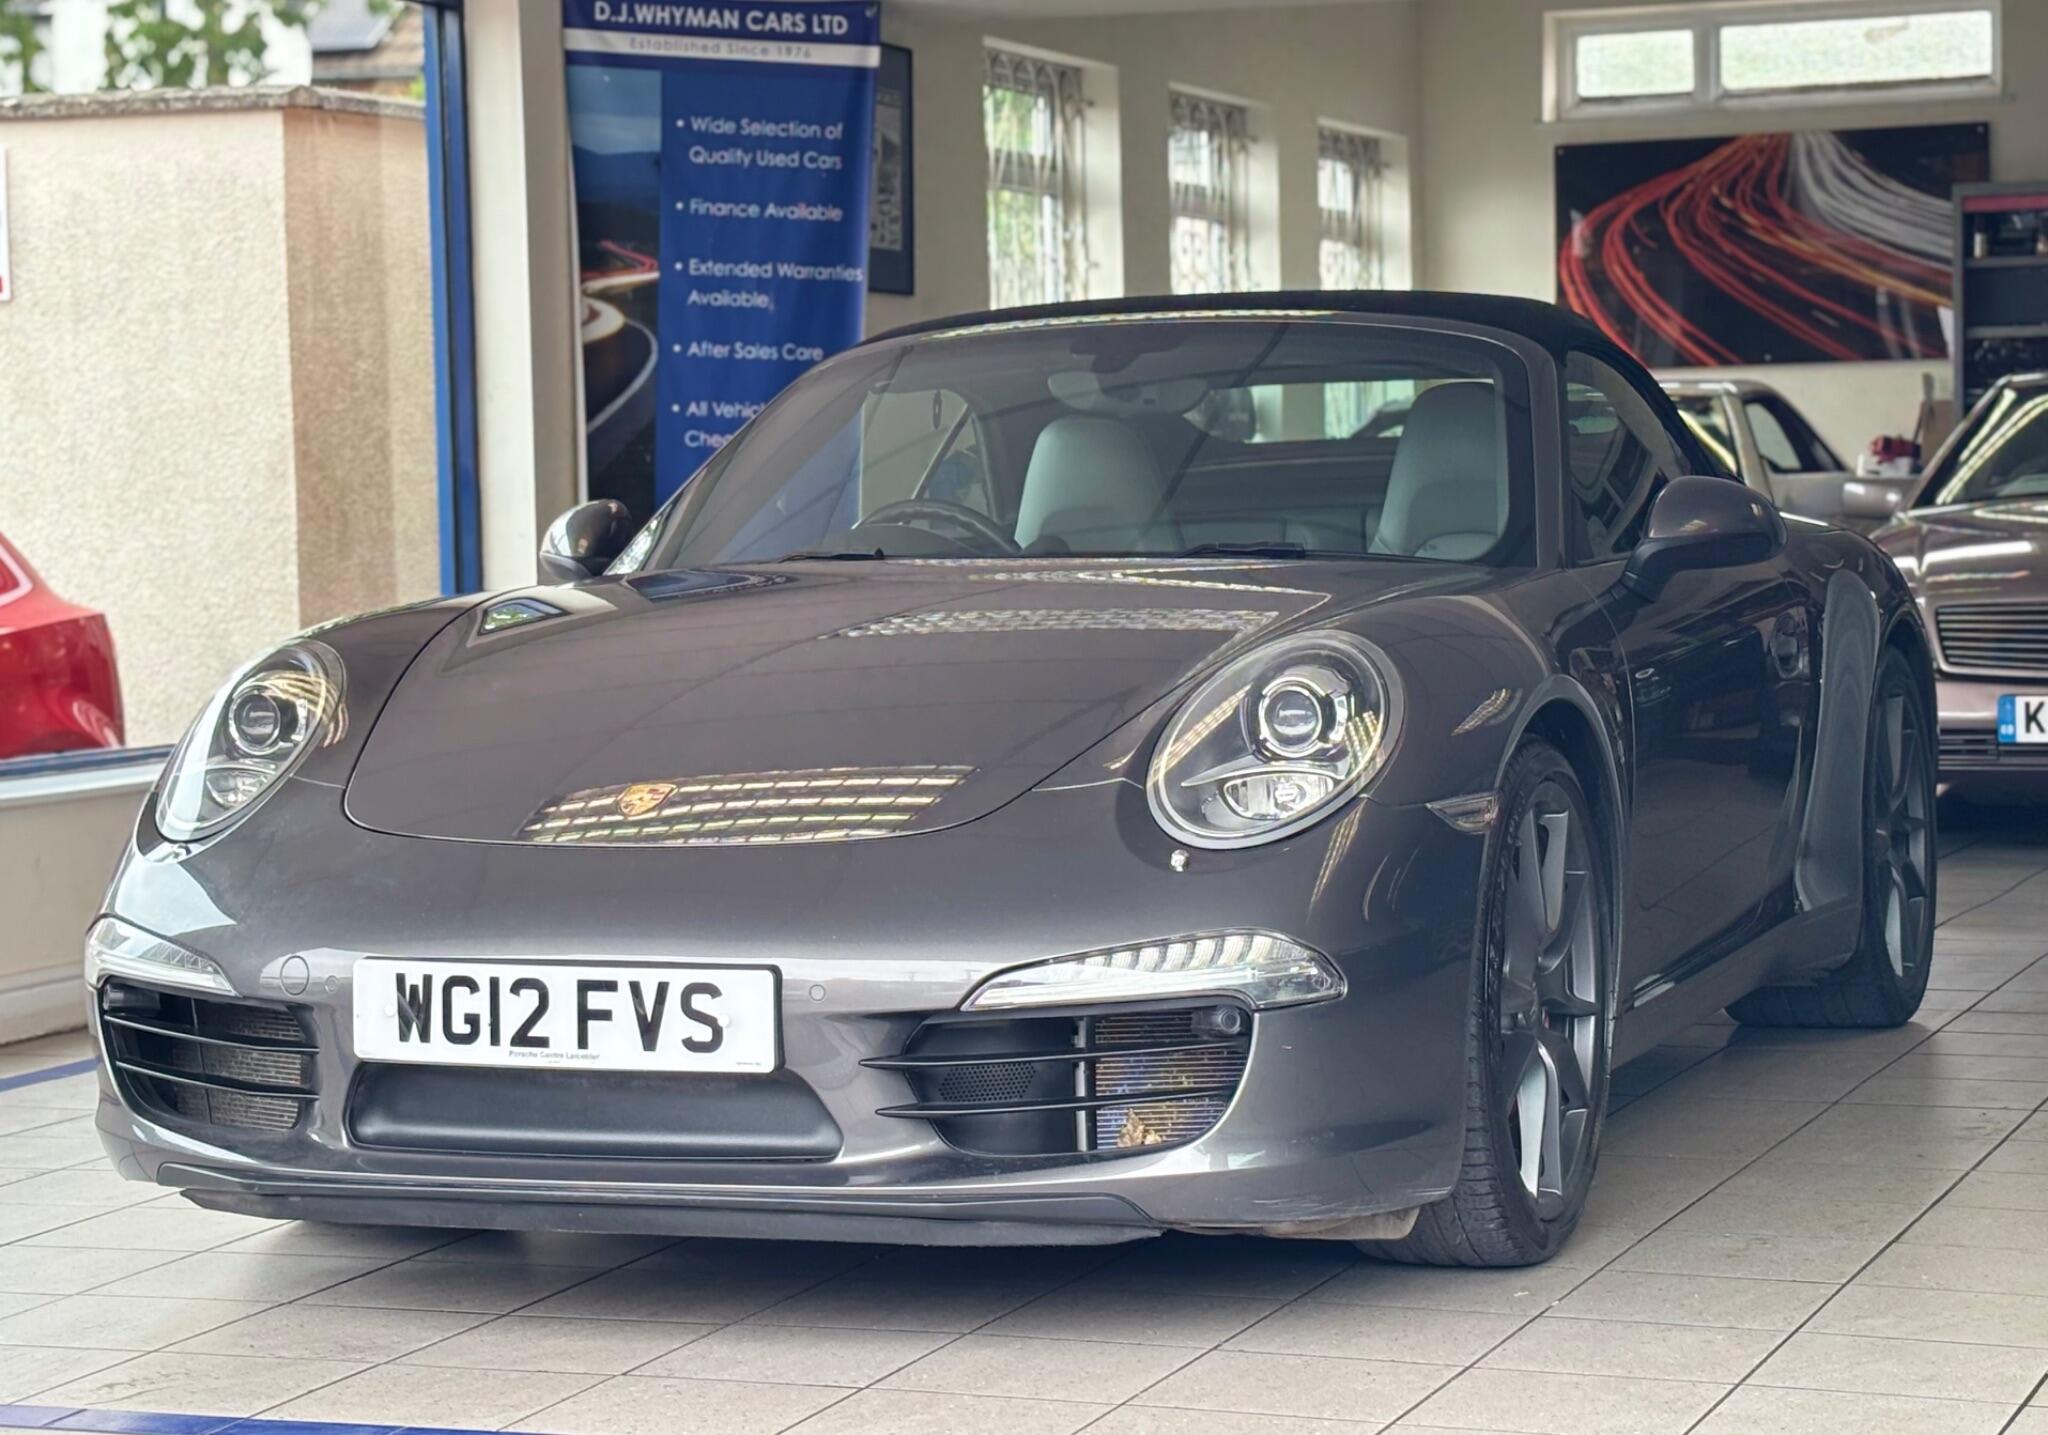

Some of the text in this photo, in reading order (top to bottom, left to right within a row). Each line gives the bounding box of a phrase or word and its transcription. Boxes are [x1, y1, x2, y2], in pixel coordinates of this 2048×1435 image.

[745, 13, 807, 34] CARS
[811, 14, 849, 36] LTD
[629, 36, 812, 59] Established Since 1976
[690, 116, 844, 140] Wide Selection of
[689, 146, 842, 170] Quality Used Cars
[690, 199, 843, 222] Finance Available
[689, 258, 863, 282] Extended Warranties
[686, 341, 824, 361] After Sales Care
[685, 401, 709, 416] All
[395, 972, 724, 1054] WG12 FVS
